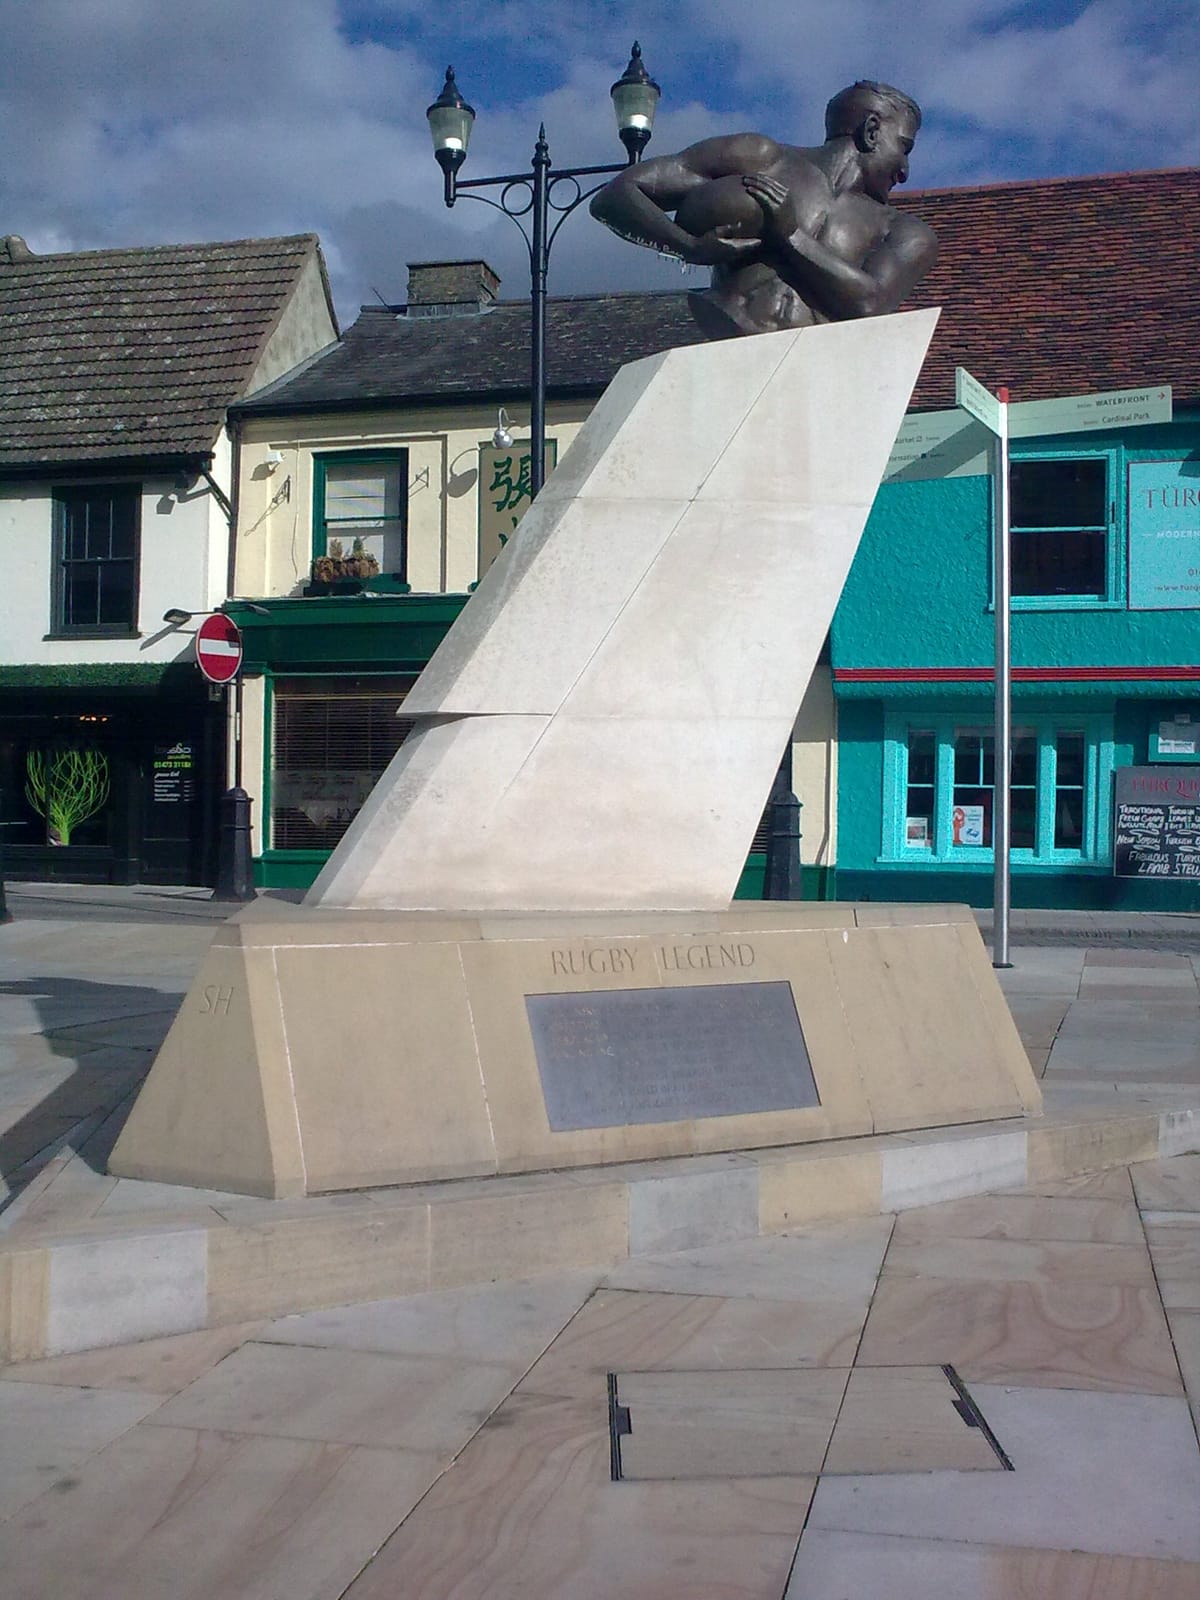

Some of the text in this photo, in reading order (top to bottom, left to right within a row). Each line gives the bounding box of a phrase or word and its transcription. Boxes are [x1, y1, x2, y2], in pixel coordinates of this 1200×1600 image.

[1096, 394, 1150, 407] WATERFRONT
[1102, 413, 1132, 424] Cardinal
[1133, 412, 1150, 420] Park
[551, 943, 755, 975] RUGBY LEGEND
[200, 985, 234, 1015] SH
